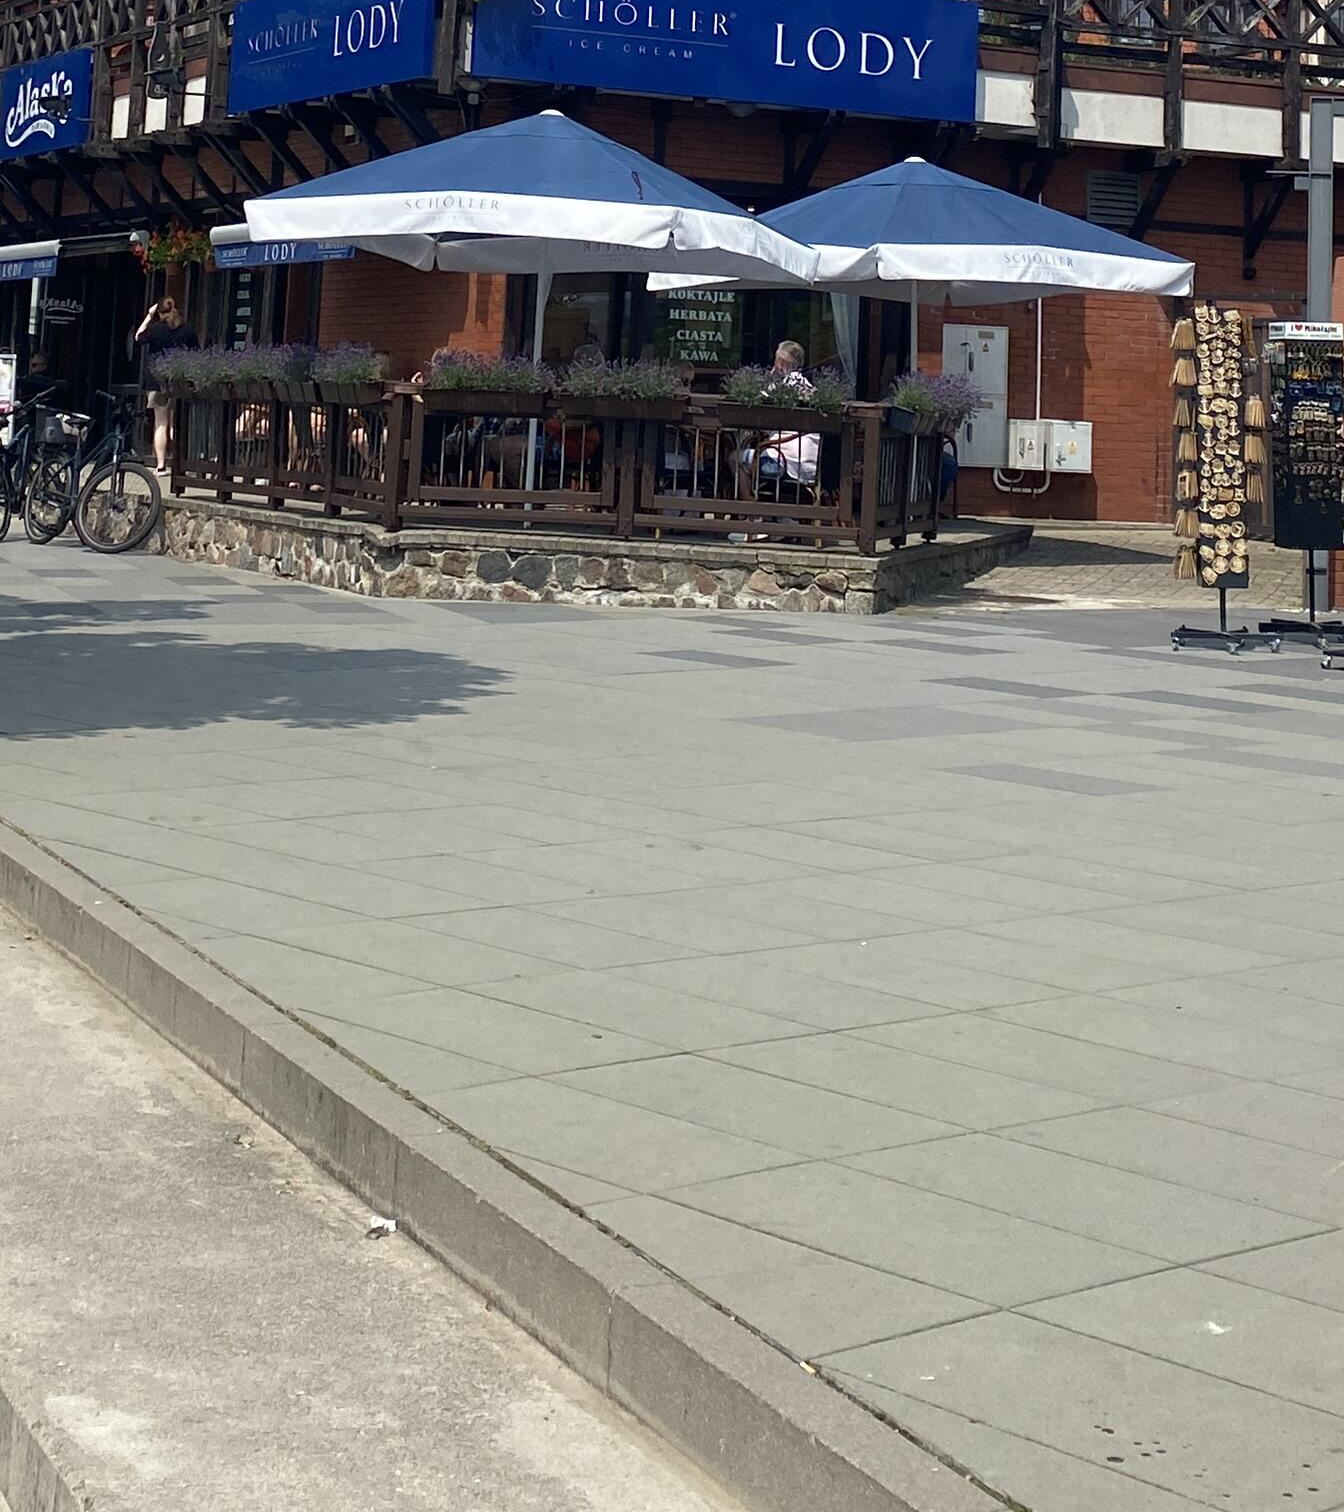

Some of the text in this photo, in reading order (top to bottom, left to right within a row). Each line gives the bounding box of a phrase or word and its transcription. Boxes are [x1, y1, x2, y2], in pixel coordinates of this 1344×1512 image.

[567, 38, 695, 60] ICE CREAM
[774, 22, 933, 80] LODY
[264, 242, 297, 261] LODY
[668, 289, 735, 304] KOKTAJLE
[669, 308, 732, 322] HERBATA
[676, 329, 723, 342] CIASTA
[680, 349, 719, 362] KAWA
